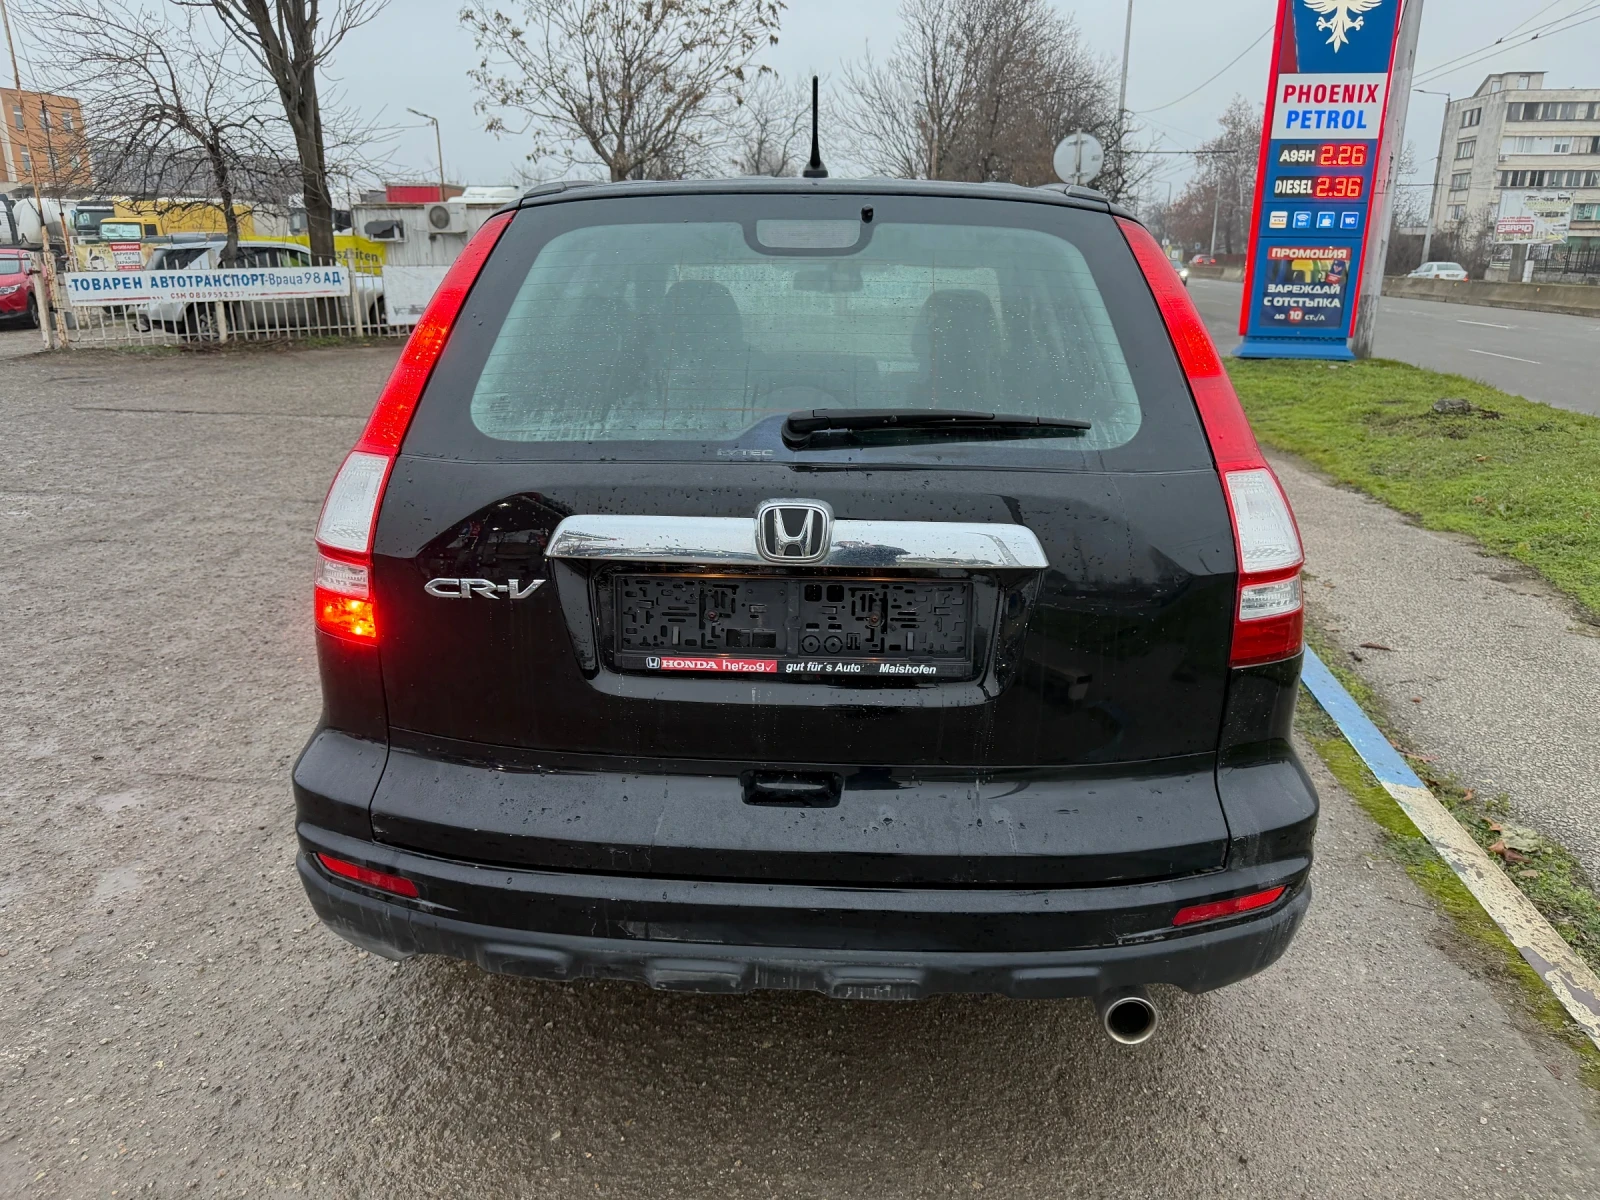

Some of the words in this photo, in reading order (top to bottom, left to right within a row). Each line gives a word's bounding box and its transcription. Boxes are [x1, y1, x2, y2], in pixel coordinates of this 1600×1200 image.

[1282, 84, 1379, 103] PHOENIX
[1285, 110, 1367, 129] PETROL
[1279, 149, 1316, 163] A95H
[1320, 145, 1365, 165] 2.26
[1274, 179, 1313, 194] DIESEL
[1316, 177, 1361, 197] 2.36
[1271, 248, 1347, 259] ПРОМОЦИЯ
[71, 276, 143, 291] ТОВАРЕН
[323, 271, 342, 286] АД
[1267, 283, 1341, 294] ЗАРЕЖДАЙ
[1273, 297, 1341, 308] ОТСТЪПКА
[1289, 311, 1302, 320] 10
[424, 577, 547, 600] CR-V
[661, 659, 718, 669] HONDA
[722, 659, 765, 672] herzog
[785, 661, 805, 673] gut
[834, 662, 862, 673] Auto
[879, 663, 937, 675] Maishofen
